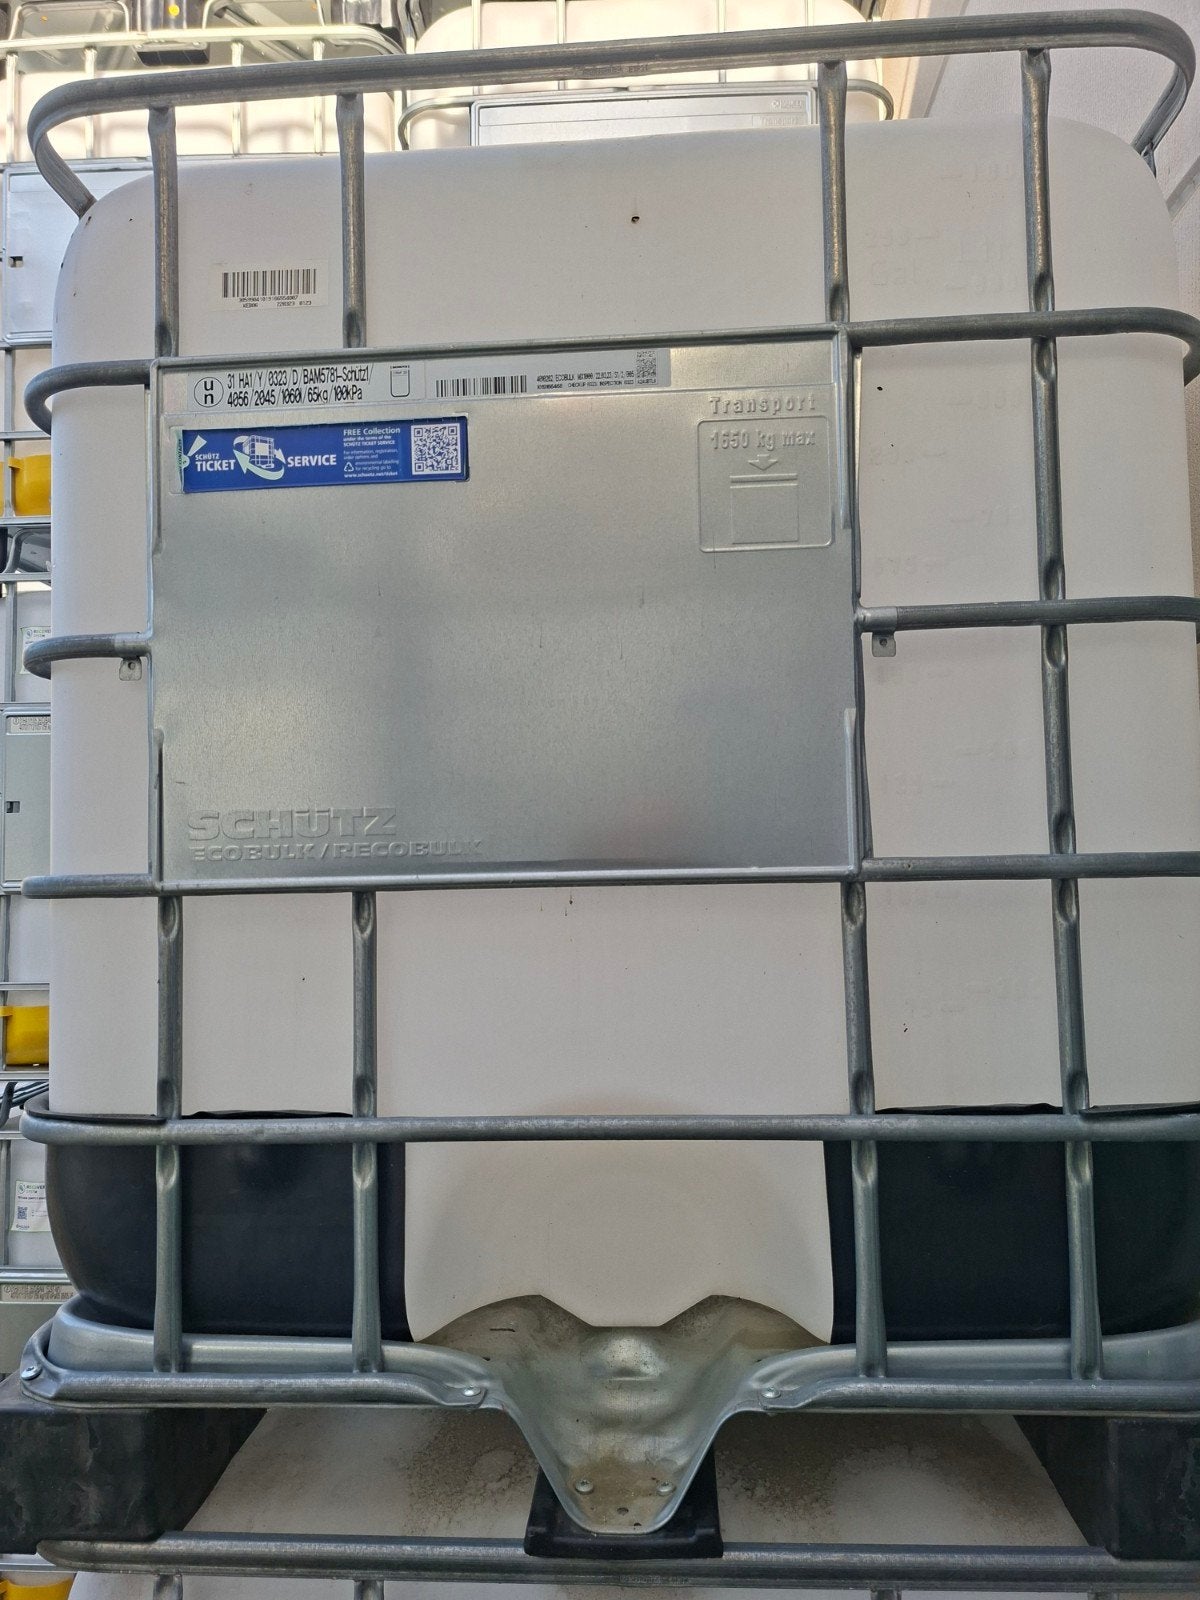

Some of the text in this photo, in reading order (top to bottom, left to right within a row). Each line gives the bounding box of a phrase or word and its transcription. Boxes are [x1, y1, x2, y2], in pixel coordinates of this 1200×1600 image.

[710, 393, 816, 415] Transport
[363, 427, 401, 435] Collection
[756, 429, 776, 451] kg
[782, 431, 816, 447] max
[195, 453, 220, 461] SCHÜTZ
[287, 454, 337, 467] SERVICE
[195, 459, 236, 472] TICKET
[187, 806, 397, 841] SCHÜTZ
